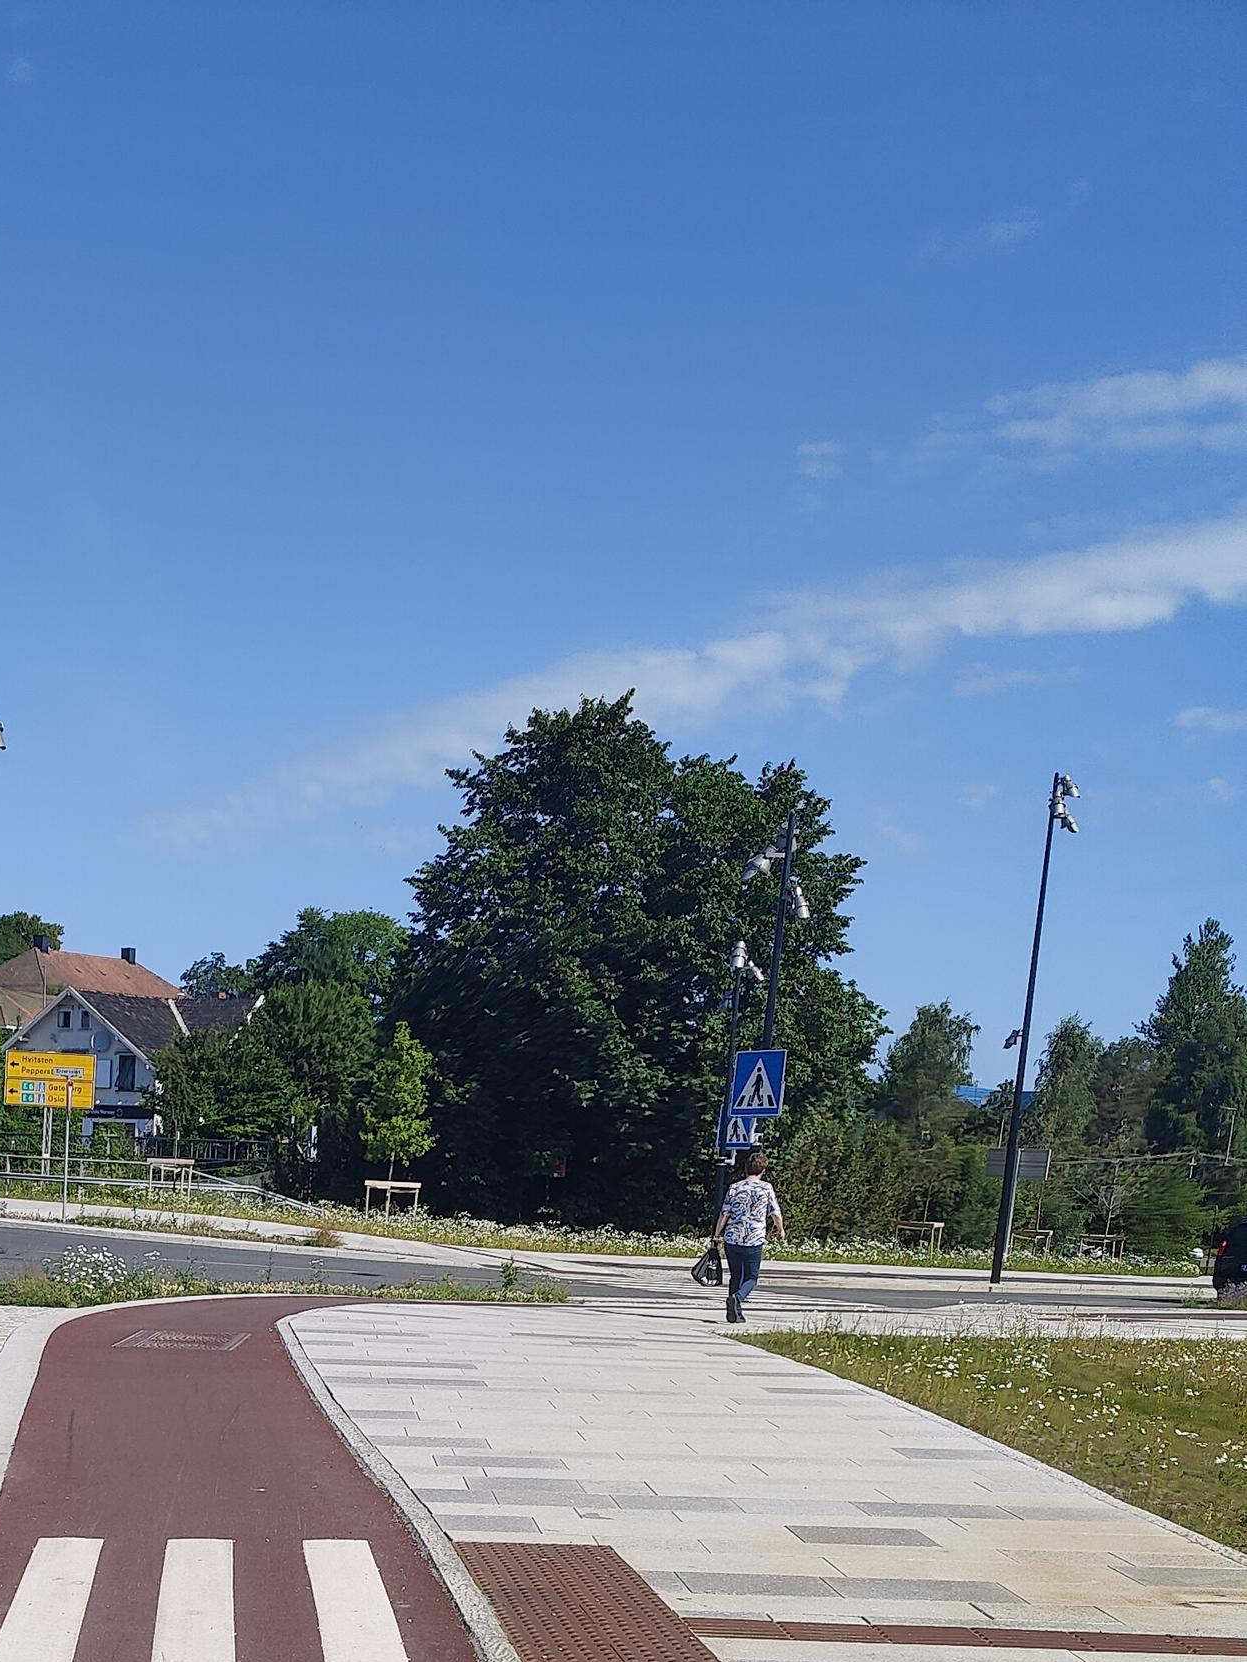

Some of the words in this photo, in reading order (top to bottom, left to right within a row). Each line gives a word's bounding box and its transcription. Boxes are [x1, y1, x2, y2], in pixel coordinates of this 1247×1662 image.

[22, 1056, 53, 1064] Hvitsten
[23, 1082, 34, 1090] E6
[48, 1084, 82, 1093] Gøteorg
[48, 1095, 65, 1103] Oslo
